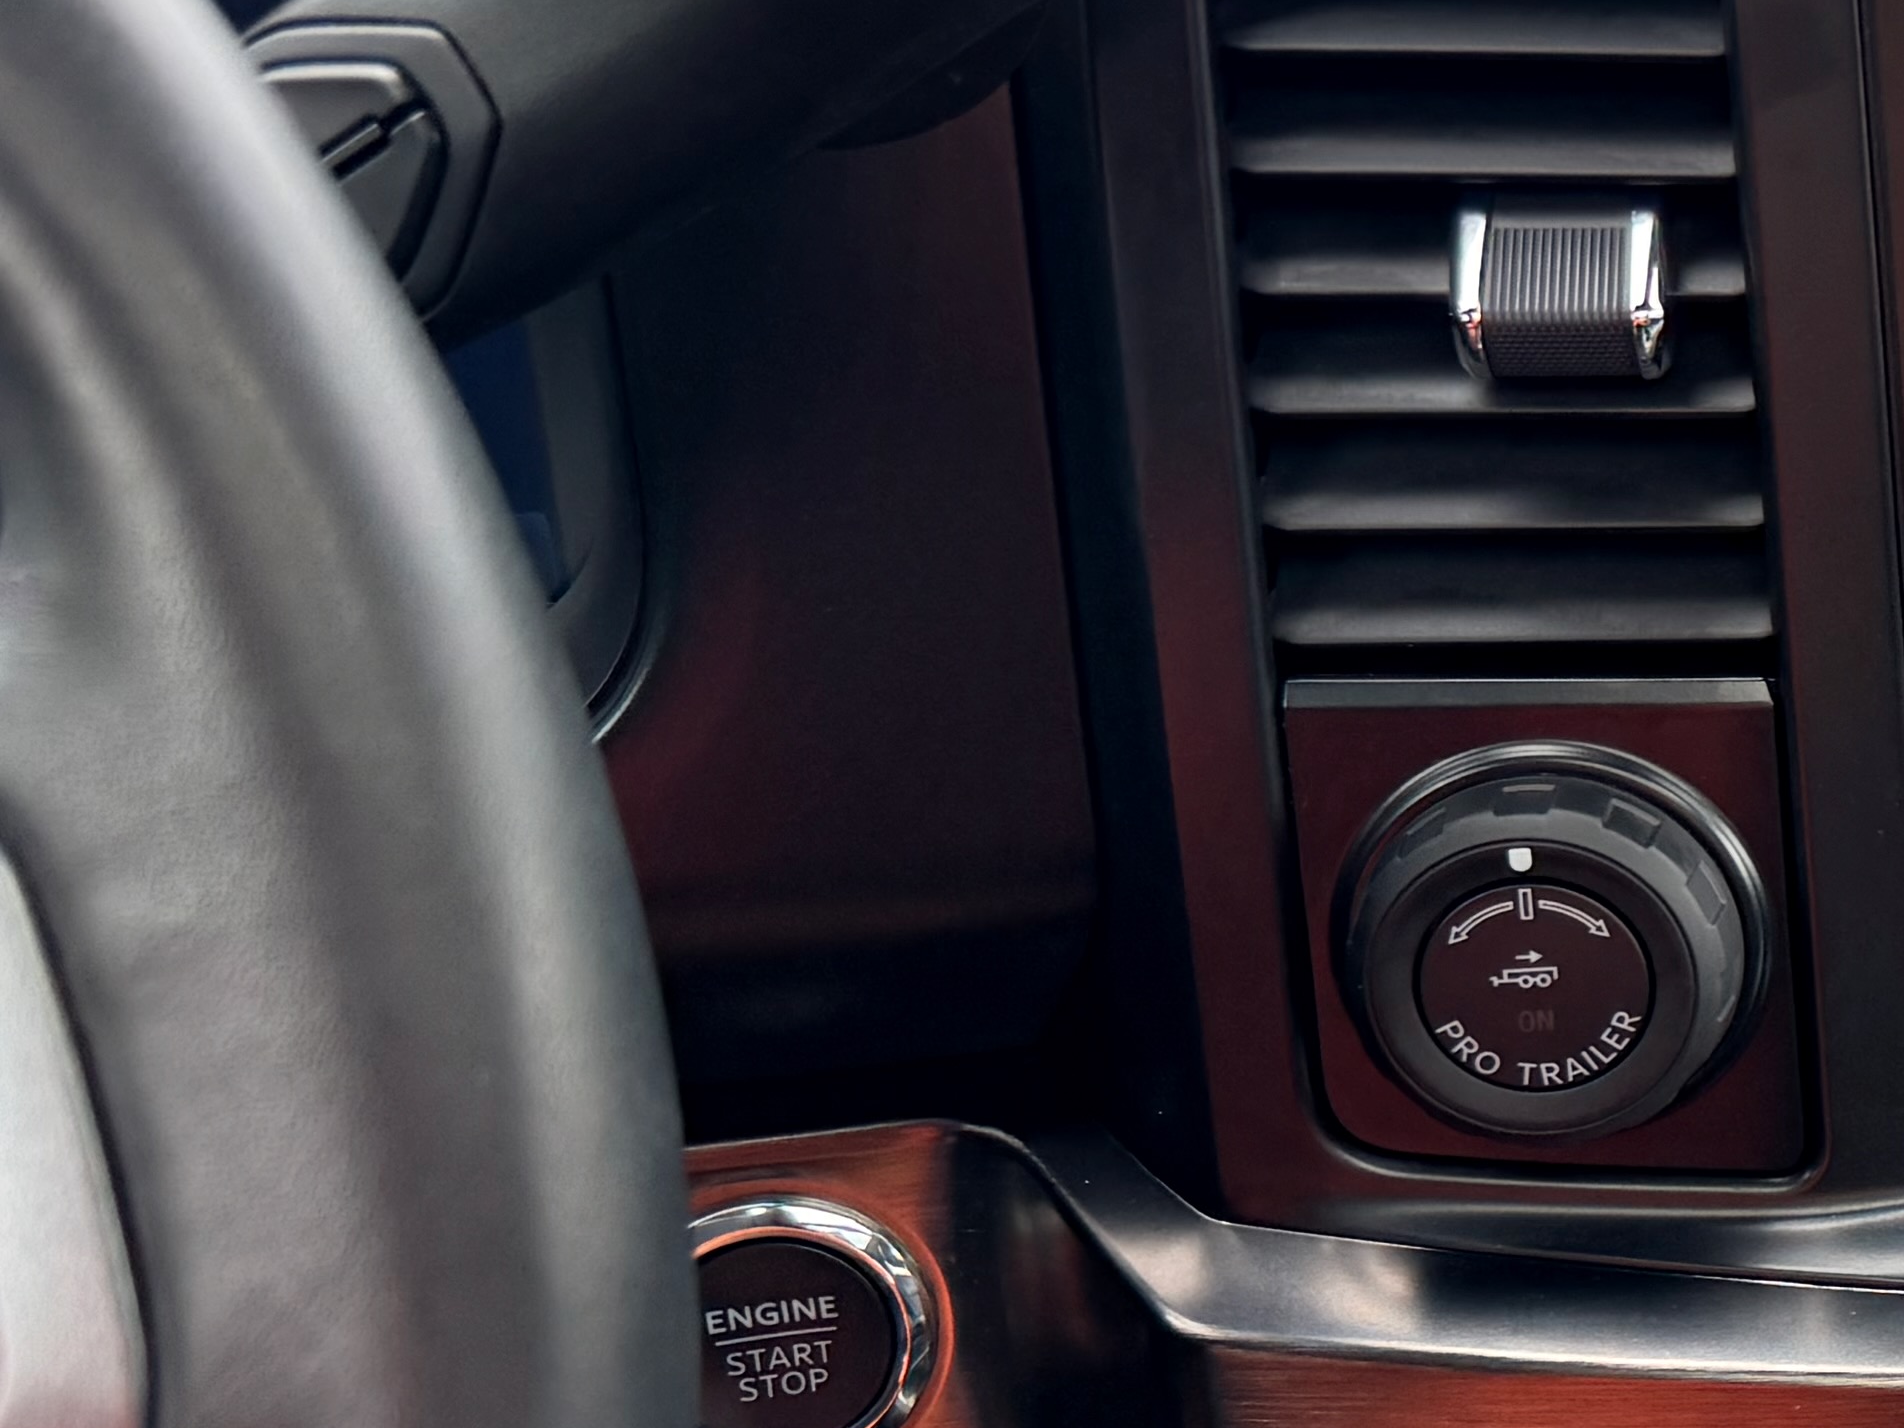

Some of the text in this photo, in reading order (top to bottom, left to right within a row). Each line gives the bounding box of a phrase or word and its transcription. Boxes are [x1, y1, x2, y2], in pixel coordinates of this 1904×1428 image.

[1434, 1009, 1643, 1086] PRO TRAILER
[704, 1295, 840, 1336] ENGINE
[725, 1340, 833, 1377] START
[738, 1367, 830, 1403] STOP
